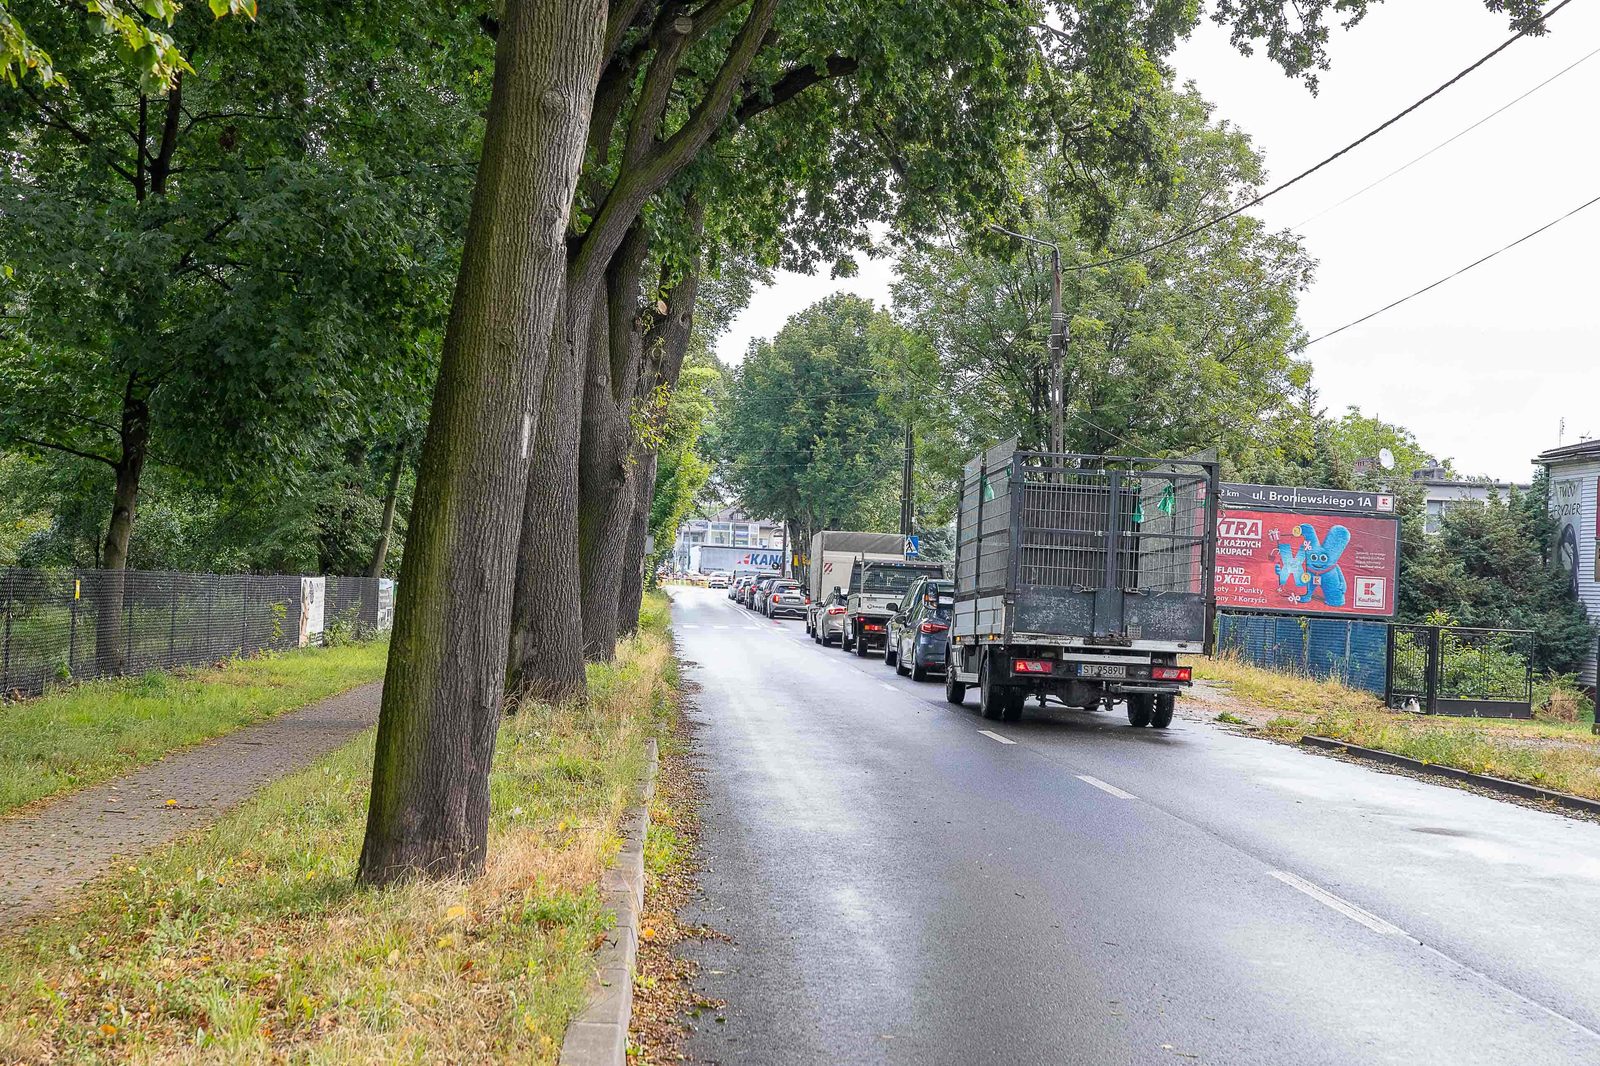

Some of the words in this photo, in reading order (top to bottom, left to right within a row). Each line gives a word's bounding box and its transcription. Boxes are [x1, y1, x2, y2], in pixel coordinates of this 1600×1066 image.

[1226, 489, 1240, 497] km
[1252, 490, 1266, 501] ul.
[1269, 491, 1355, 507] Broniewskiego
[1358, 497, 1372, 507] 1A
[1223, 538, 1262, 548] KAŻDYCH
[1216, 547, 1253, 556] AKUPACH
[750, 553, 783, 566] KAN
[1239, 586, 1264, 595] Punkty
